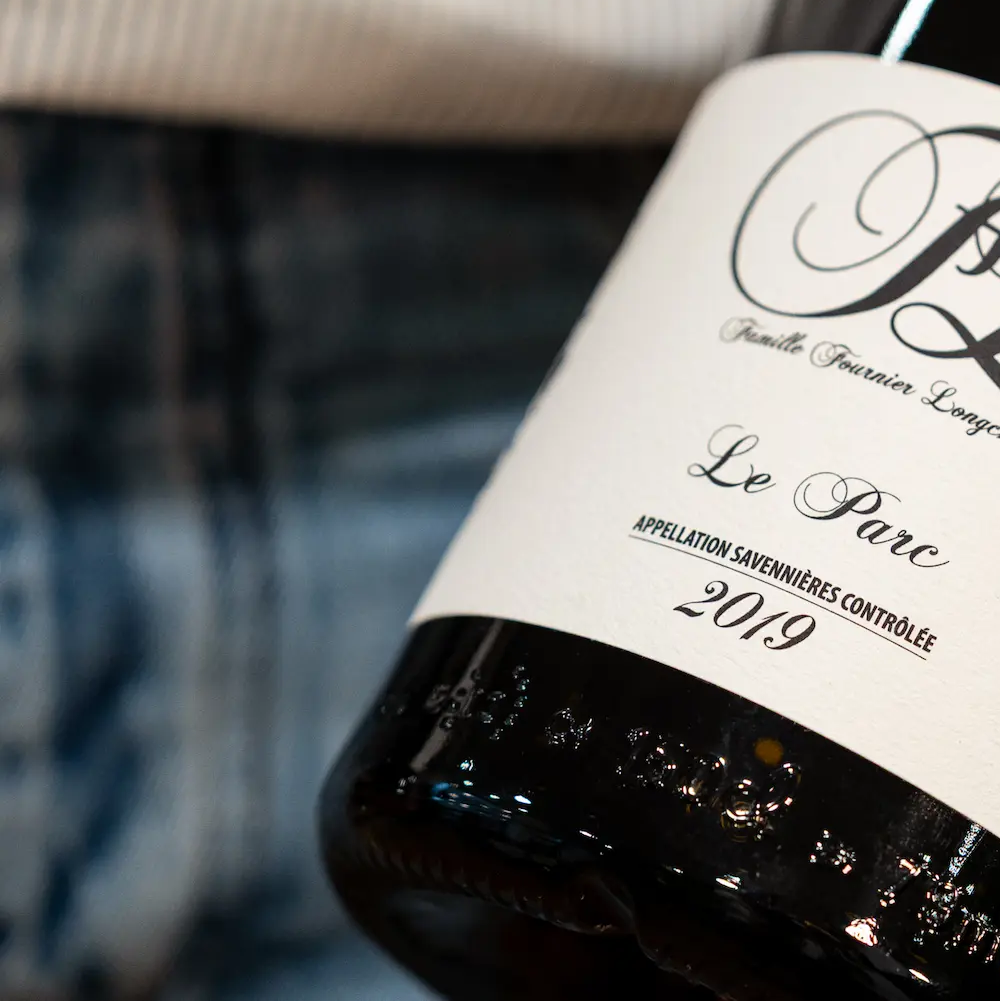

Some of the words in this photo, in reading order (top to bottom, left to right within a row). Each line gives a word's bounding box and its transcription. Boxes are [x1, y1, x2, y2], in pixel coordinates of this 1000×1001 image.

[718, 316, 805, 357] Famille
[809, 340, 917, 396] Fournier
[686, 423, 777, 495] Le
[793, 470, 950, 569] Parc
[632, 514, 730, 560] APPELLATION
[729, 544, 842, 606] SAVENNIÈRES
[840, 591, 939, 655] CONTRÔLÉE
[673, 579, 817, 653] 2019
